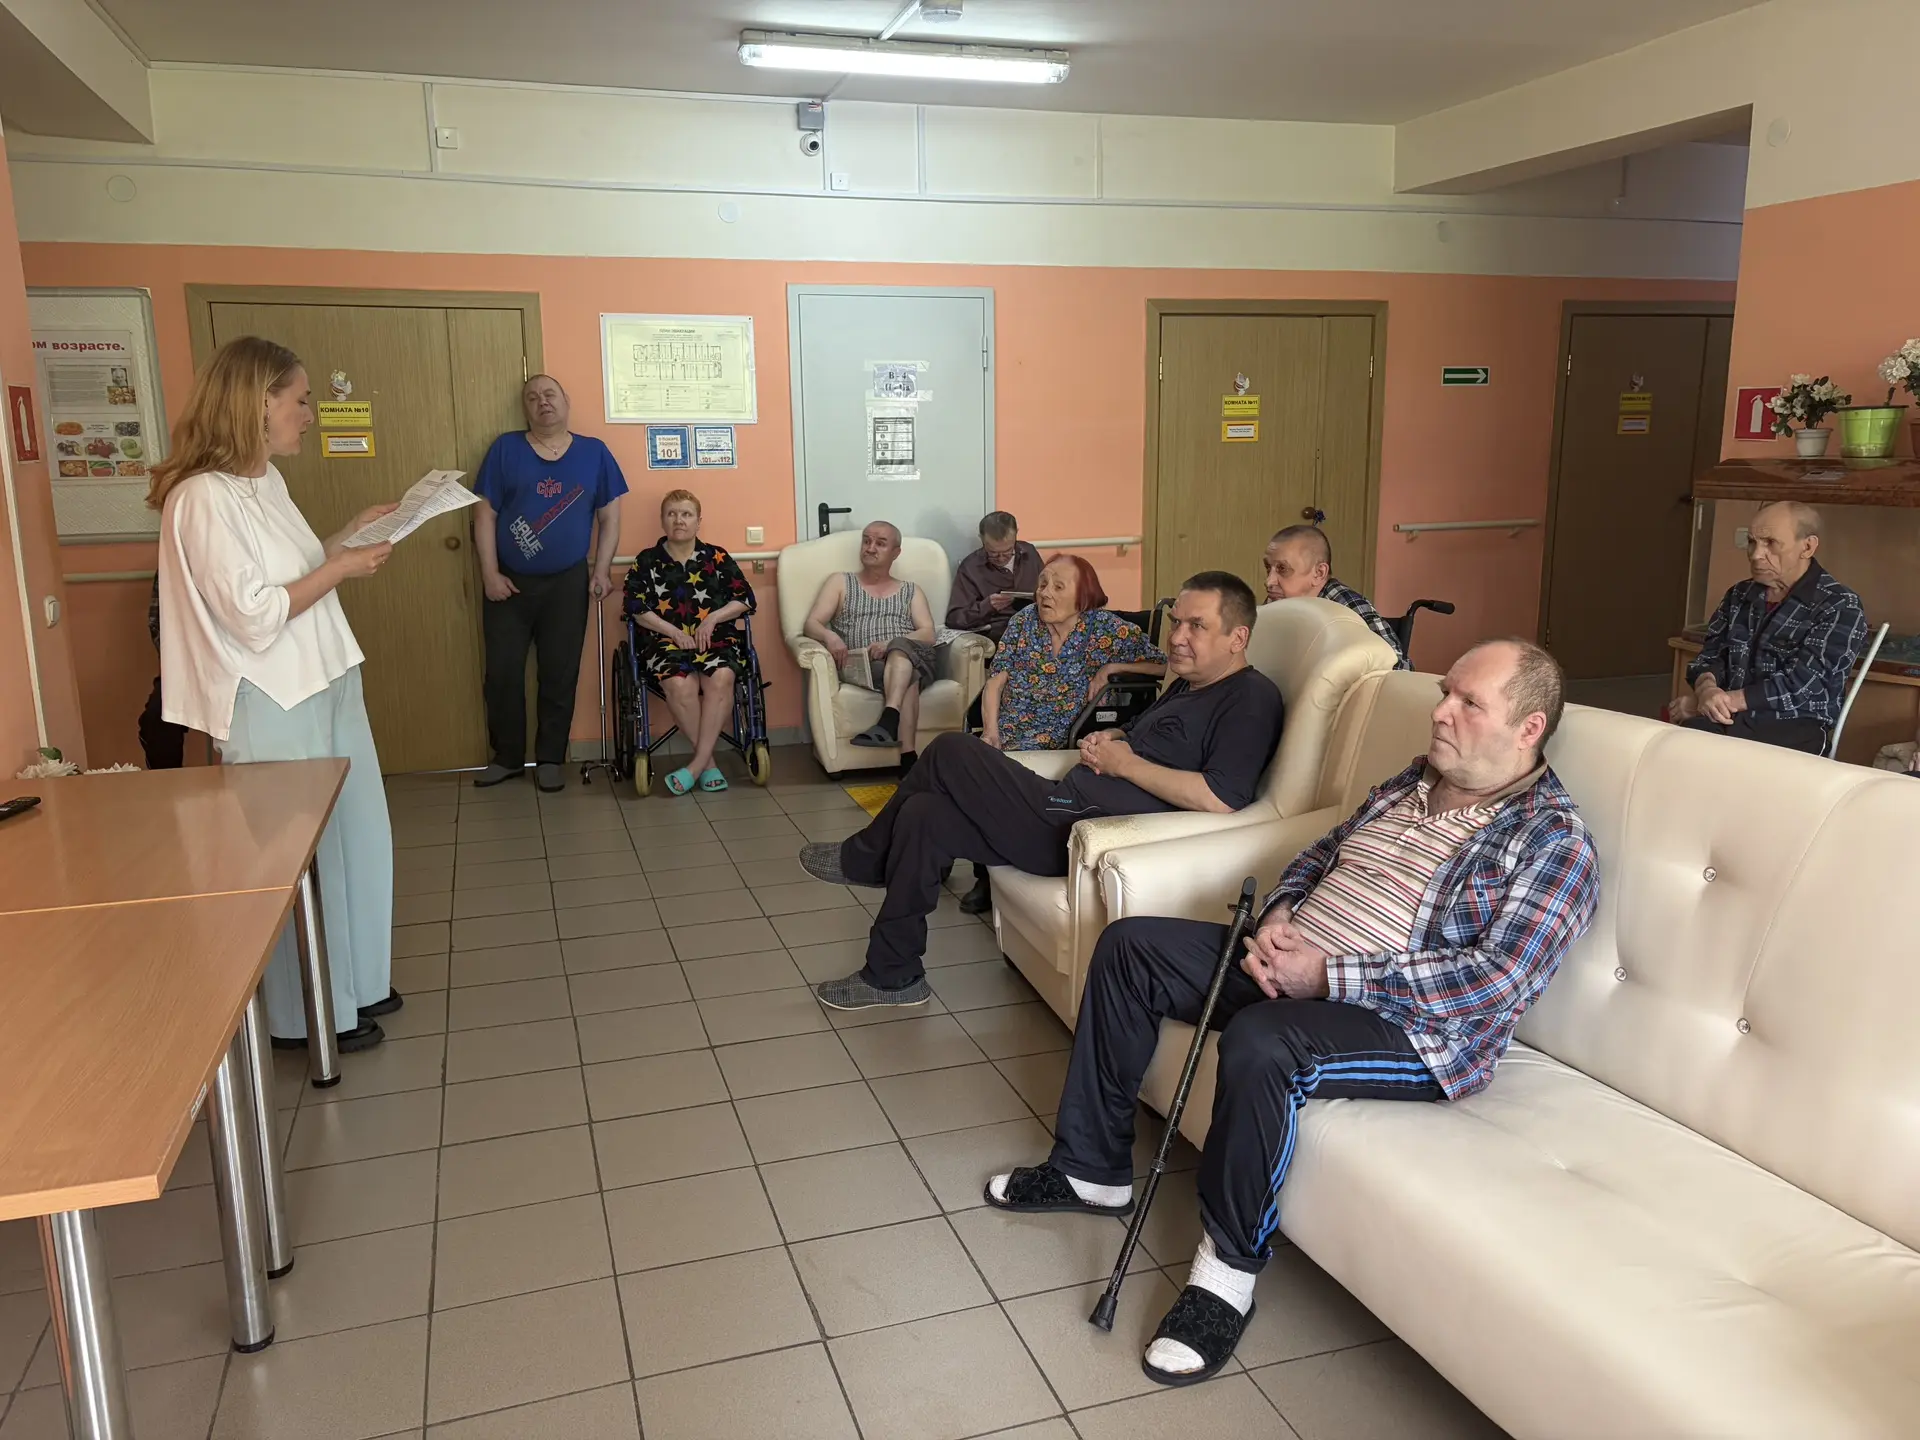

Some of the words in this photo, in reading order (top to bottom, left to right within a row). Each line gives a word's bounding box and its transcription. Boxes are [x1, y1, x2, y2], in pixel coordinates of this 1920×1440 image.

[52, 341, 125, 352] возрасте.
[661, 448, 678, 458] 101
[509, 523, 534, 561] ОРУЖИЕ
[514, 515, 544, 555] НАШЕ
